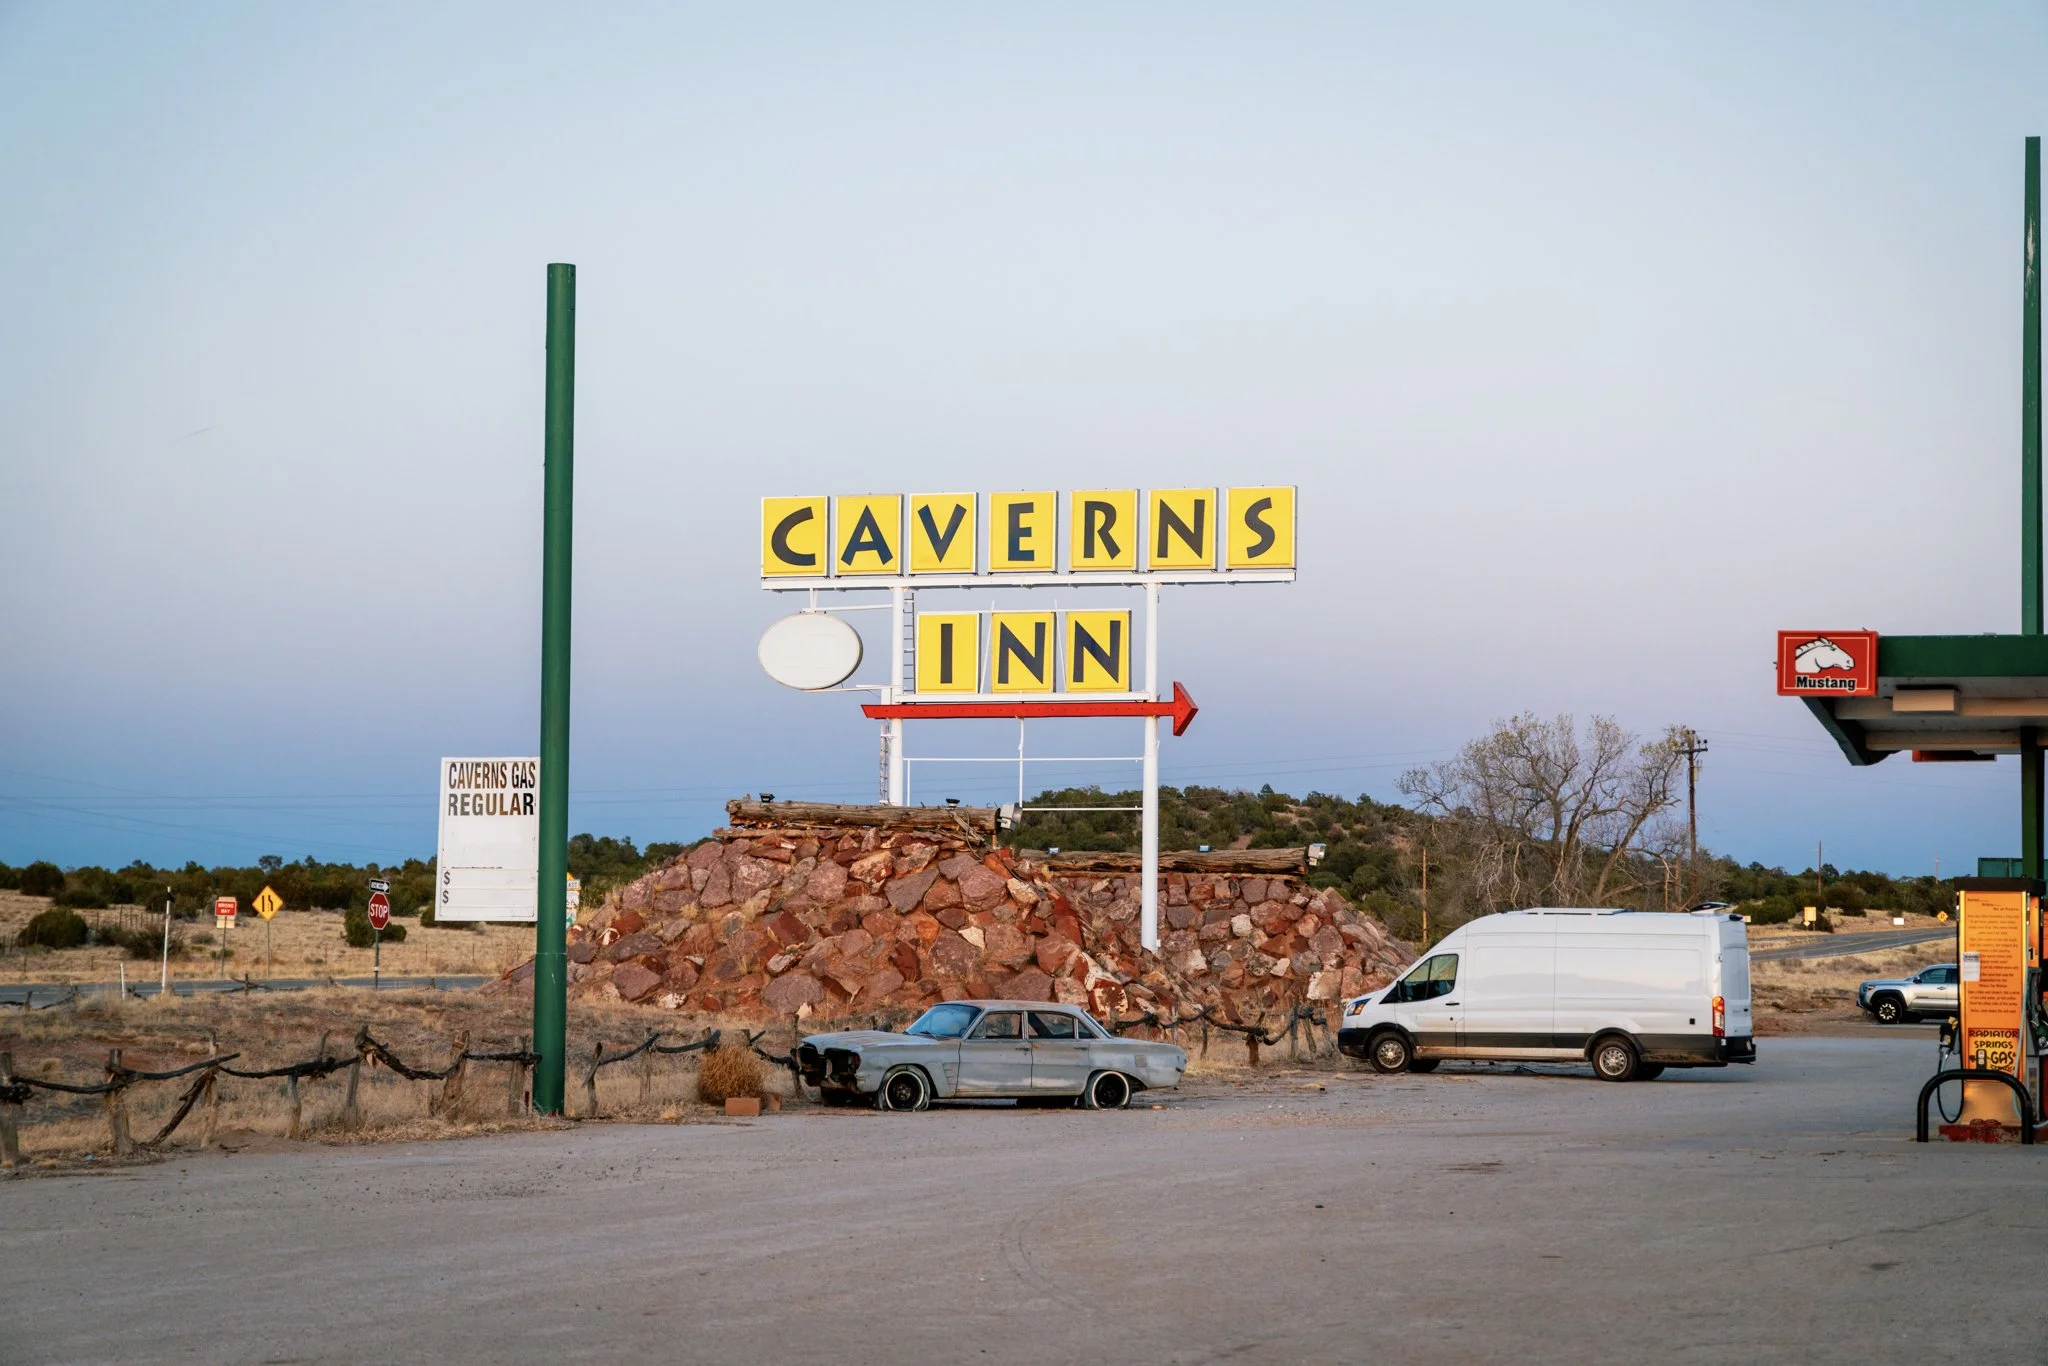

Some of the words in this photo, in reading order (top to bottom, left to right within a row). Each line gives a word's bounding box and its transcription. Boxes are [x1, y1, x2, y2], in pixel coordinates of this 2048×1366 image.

[770, 496, 1276, 567] CAVERNS
[940, 619, 1121, 685] INN
[1796, 675, 1857, 692] Mustang
[449, 762, 507, 789] CAVERNS
[511, 762, 536, 789] GAS
[448, 793, 534, 816] REGULAR
[443, 870, 451, 886] $
[442, 889, 449, 905] $
[370, 903, 388, 918] STOP
[1968, 1029, 2019, 1039] RADIATOR
[1974, 1040, 2014, 1049] SPRINGS
[1990, 1051, 2014, 1065] GAS
